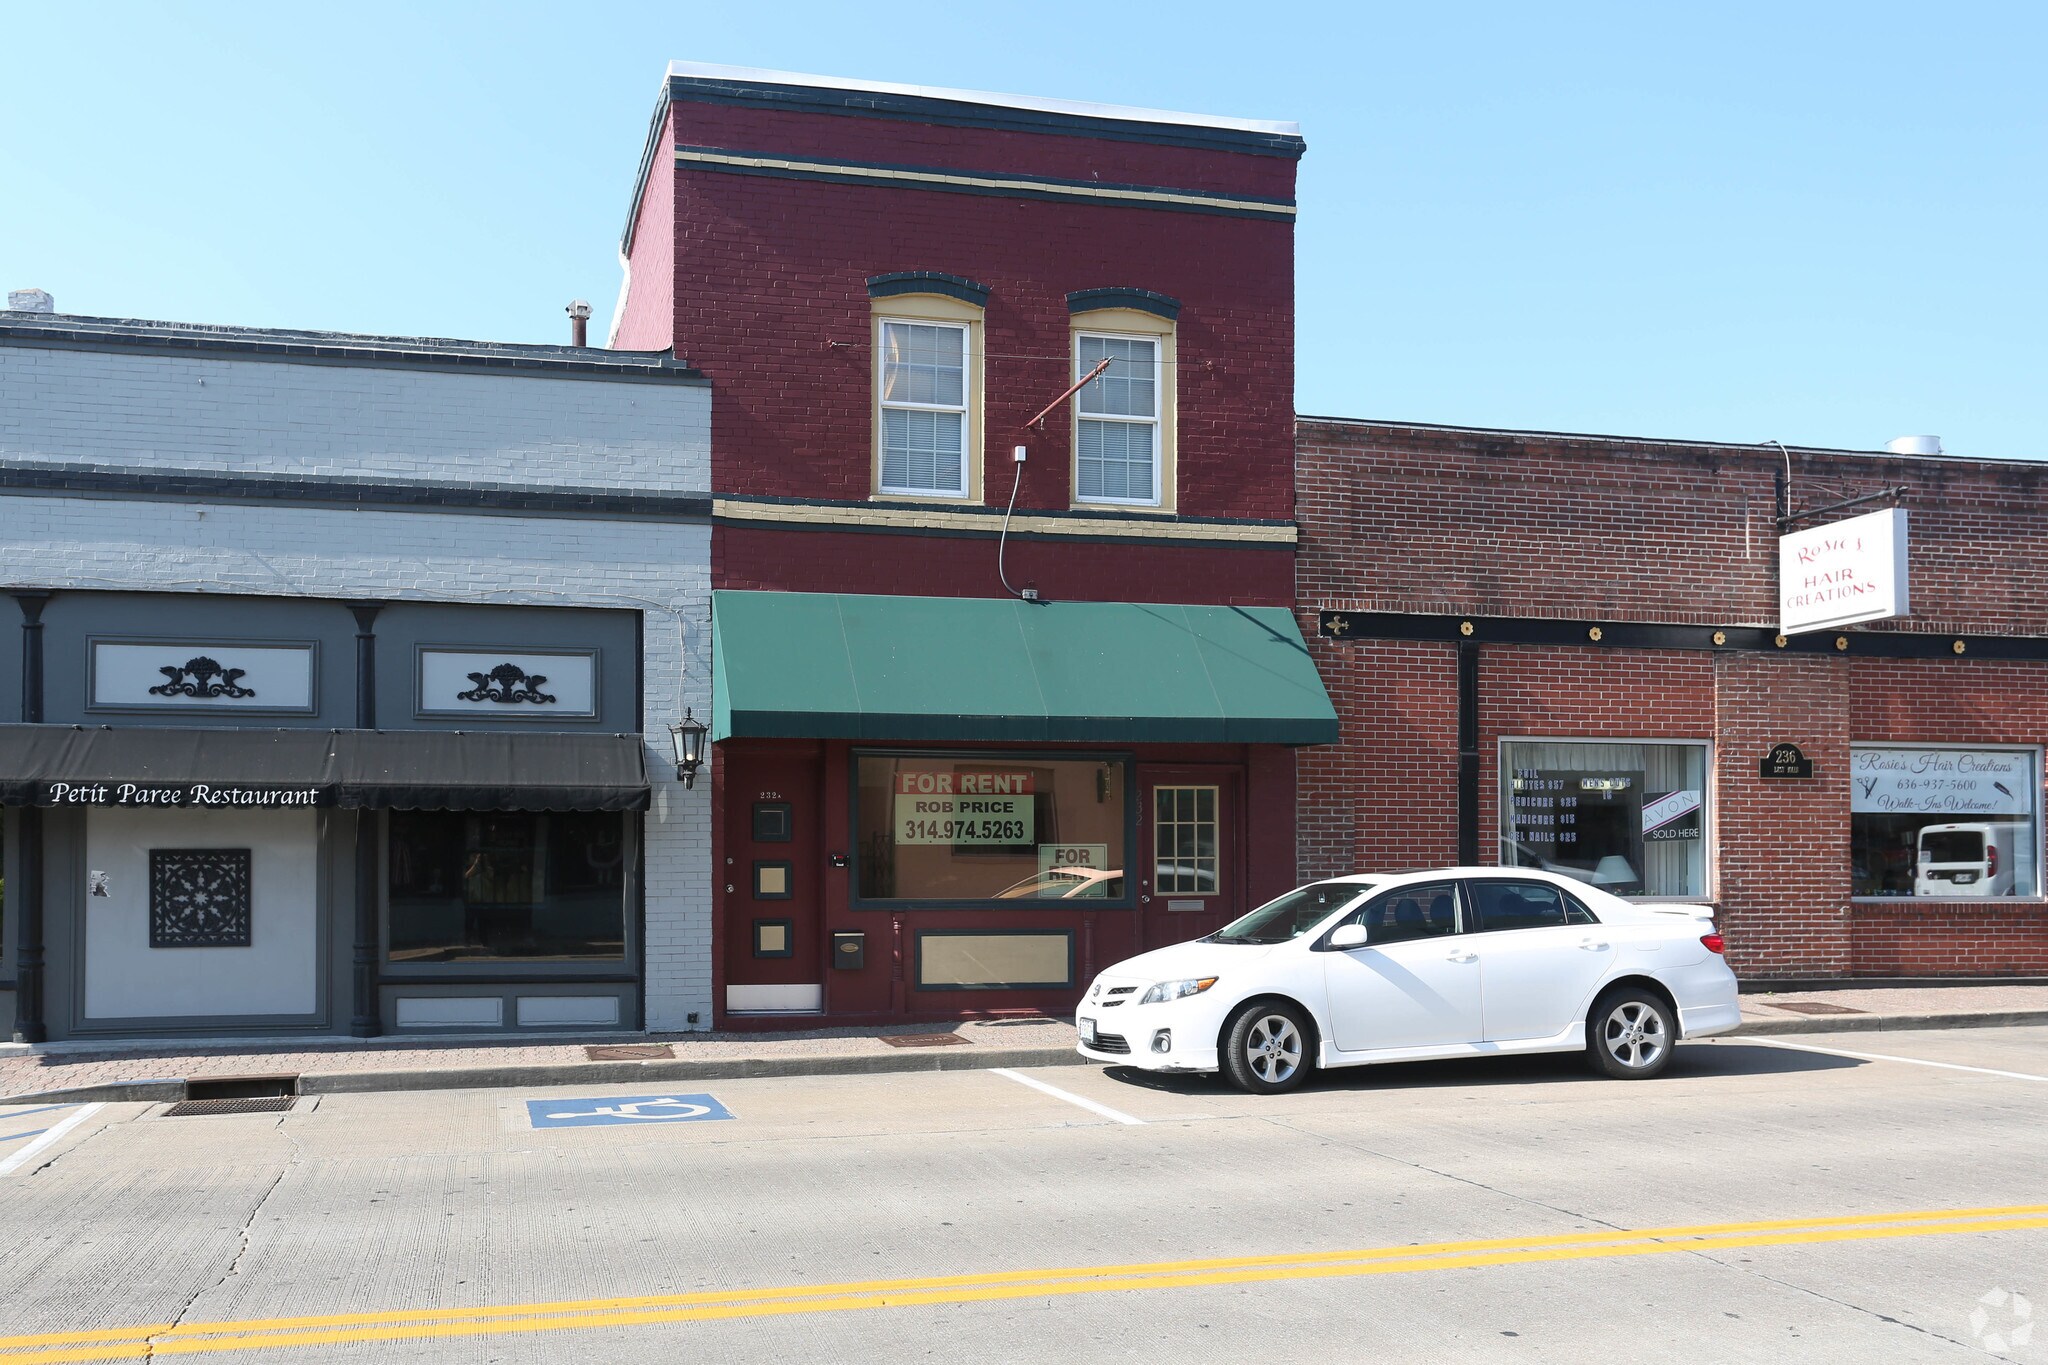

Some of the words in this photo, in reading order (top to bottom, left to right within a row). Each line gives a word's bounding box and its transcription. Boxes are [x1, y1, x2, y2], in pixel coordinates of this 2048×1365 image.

[1804, 568, 1853, 588] HAIR
[1786, 580, 1876, 609] CREATIONS
[1775, 749, 1796, 764] 236
[1910, 753, 1953, 774] Hair
[902, 773, 953, 793] FOR
[961, 774, 1027, 794] RENT
[1510, 780, 1545, 790] HILITES
[1582, 778, 1605, 788] MENS
[1609, 778, 1631, 788] CUTS
[1896, 778, 1977, 791] 636-937-5600
[49, 782, 108, 803] Petit
[116, 783, 181, 804] Paree
[190, 784, 319, 805] Restaurant
[915, 801, 954, 813] ROB
[959, 801, 1014, 813] PRICE
[1510, 797, 1554, 807] PEDICURE
[1560, 797, 1577, 807] $25
[1644, 793, 1694, 826] AVON
[1876, 794, 1943, 811] Walk-Ins
[1944, 796, 1998, 811] Welcome!
[1510, 814, 1555, 825] MANICURE
[1560, 814, 1575, 824] $15
[905, 820, 1024, 839] 314.974.5263
[1510, 831, 1525, 842] GEL
[1529, 832, 1555, 842] NAILS
[1560, 832, 1577, 842] $25
[1653, 829, 1677, 839] SOLD
[1678, 828, 1699, 838] HERE
[1055, 848, 1091, 864] FOR
